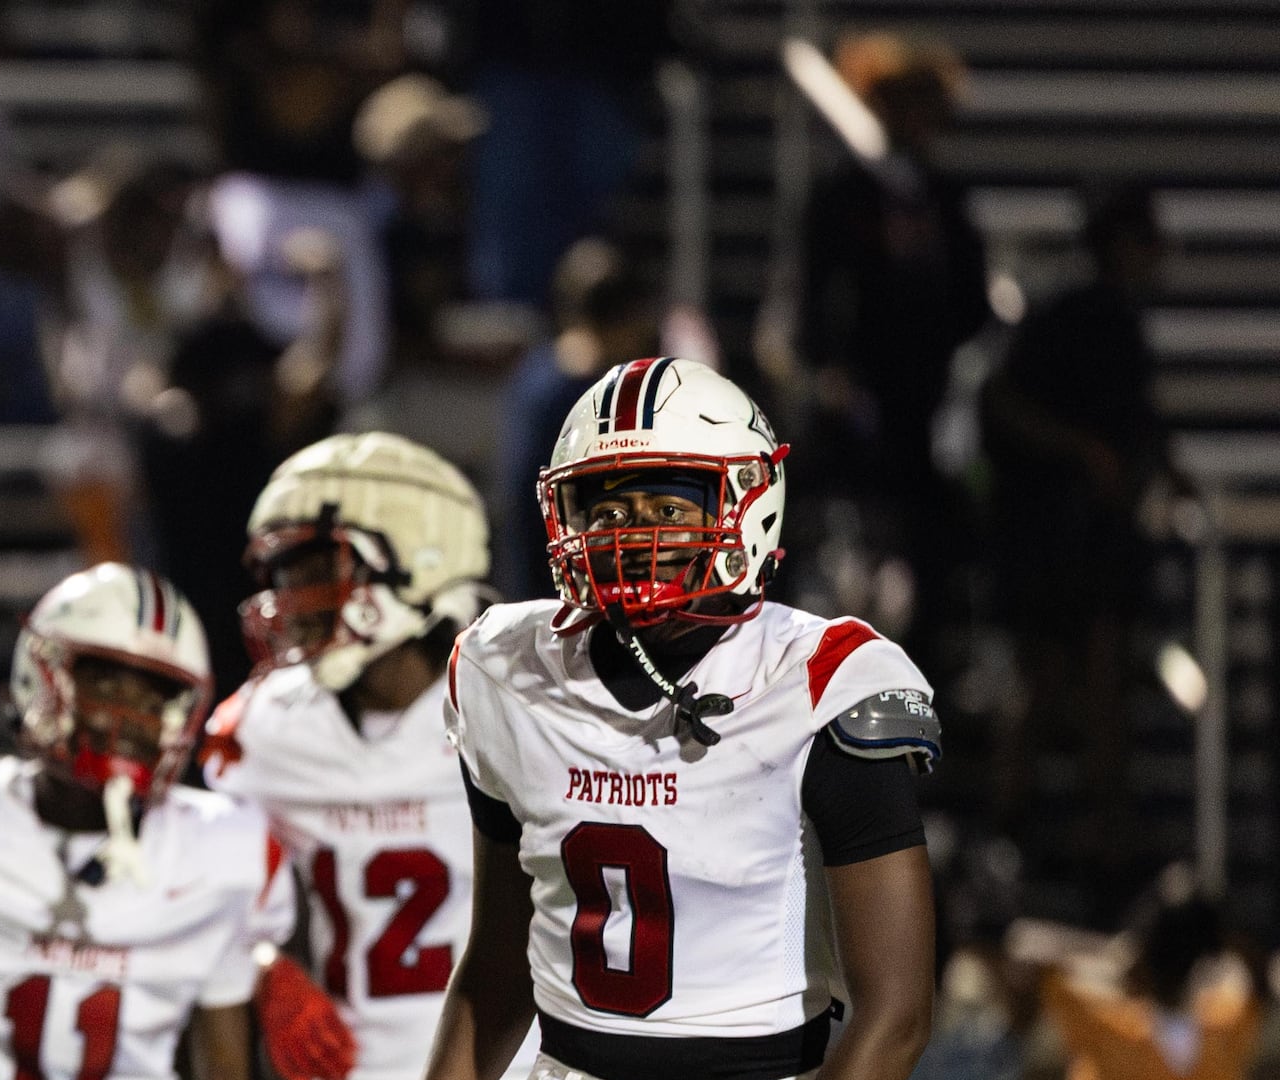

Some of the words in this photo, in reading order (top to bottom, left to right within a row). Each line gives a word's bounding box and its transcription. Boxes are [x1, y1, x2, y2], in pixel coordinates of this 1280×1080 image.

[566, 767, 677, 806] PATRIOTS
[312, 847, 454, 998] 12
[561, 821, 675, 1018] 0
